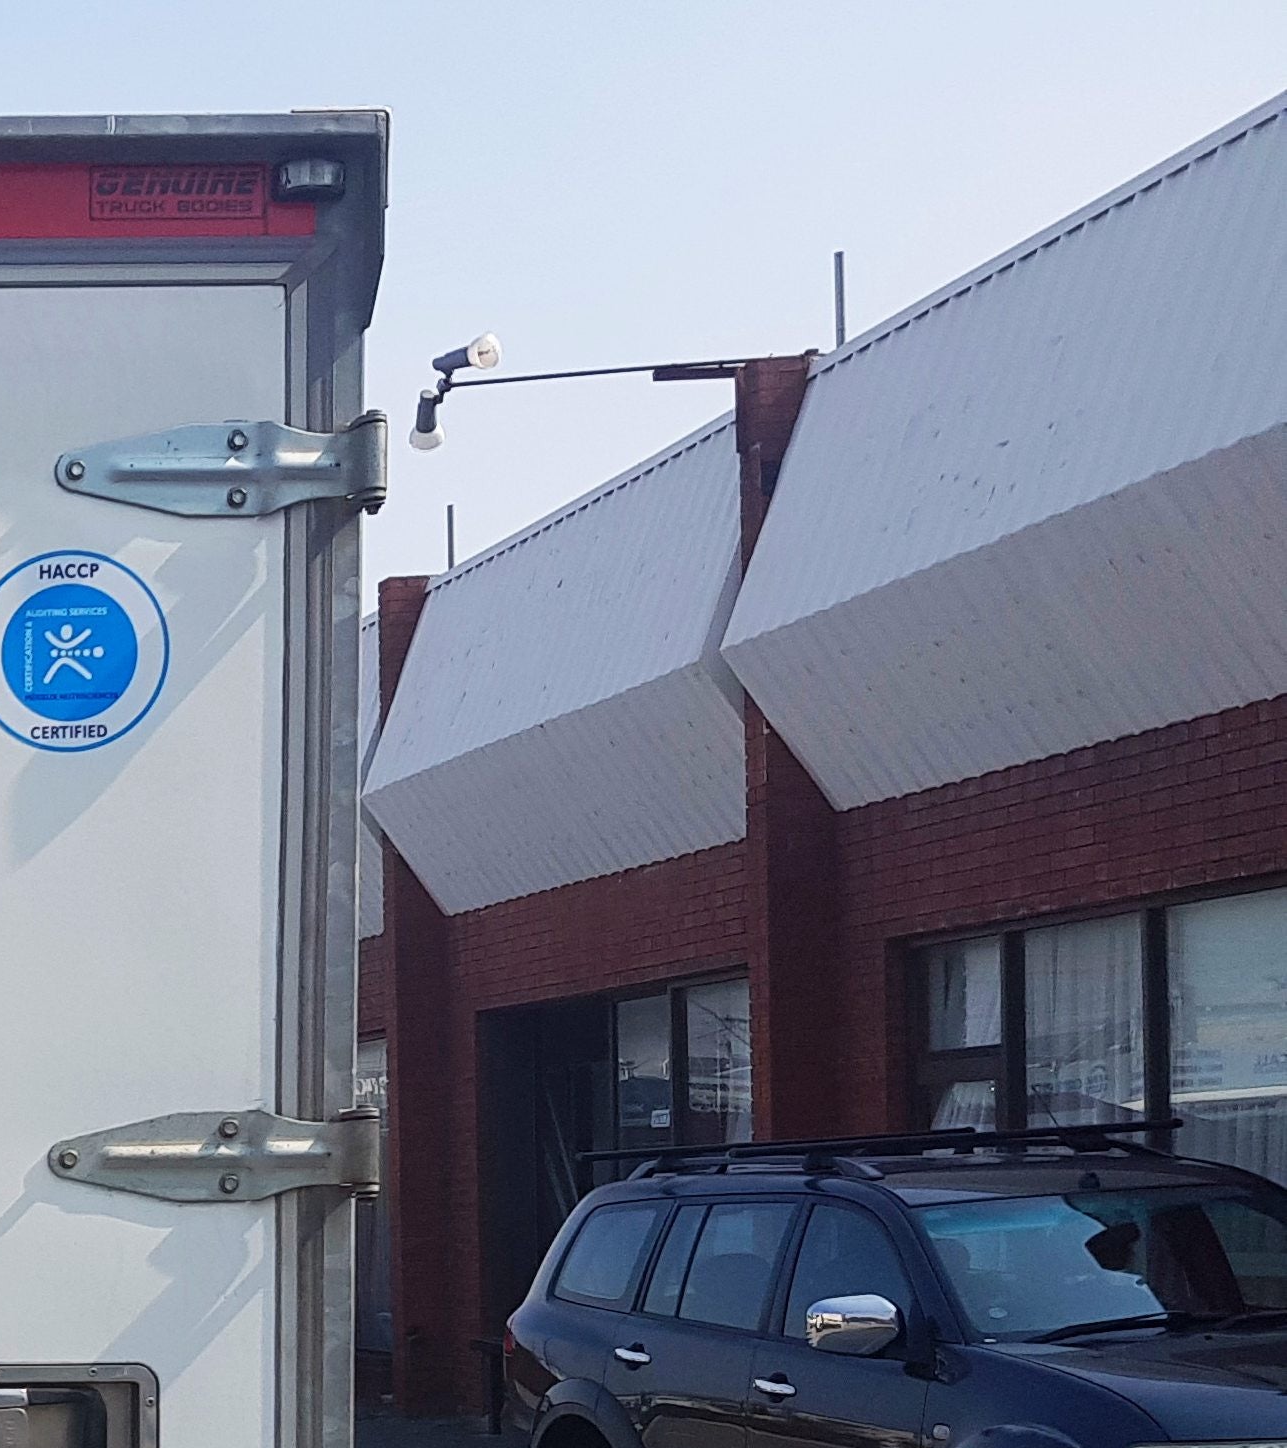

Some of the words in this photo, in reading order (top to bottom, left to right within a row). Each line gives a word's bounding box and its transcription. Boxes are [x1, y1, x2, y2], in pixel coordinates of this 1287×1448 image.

[96, 171, 260, 196] GENUINE
[96, 201, 164, 213] TRUCK
[177, 200, 252, 213] BODIES
[39, 563, 100, 579] HACCP
[69, 606, 108, 617] SERVICES
[30, 724, 108, 740] CERTIFIED
